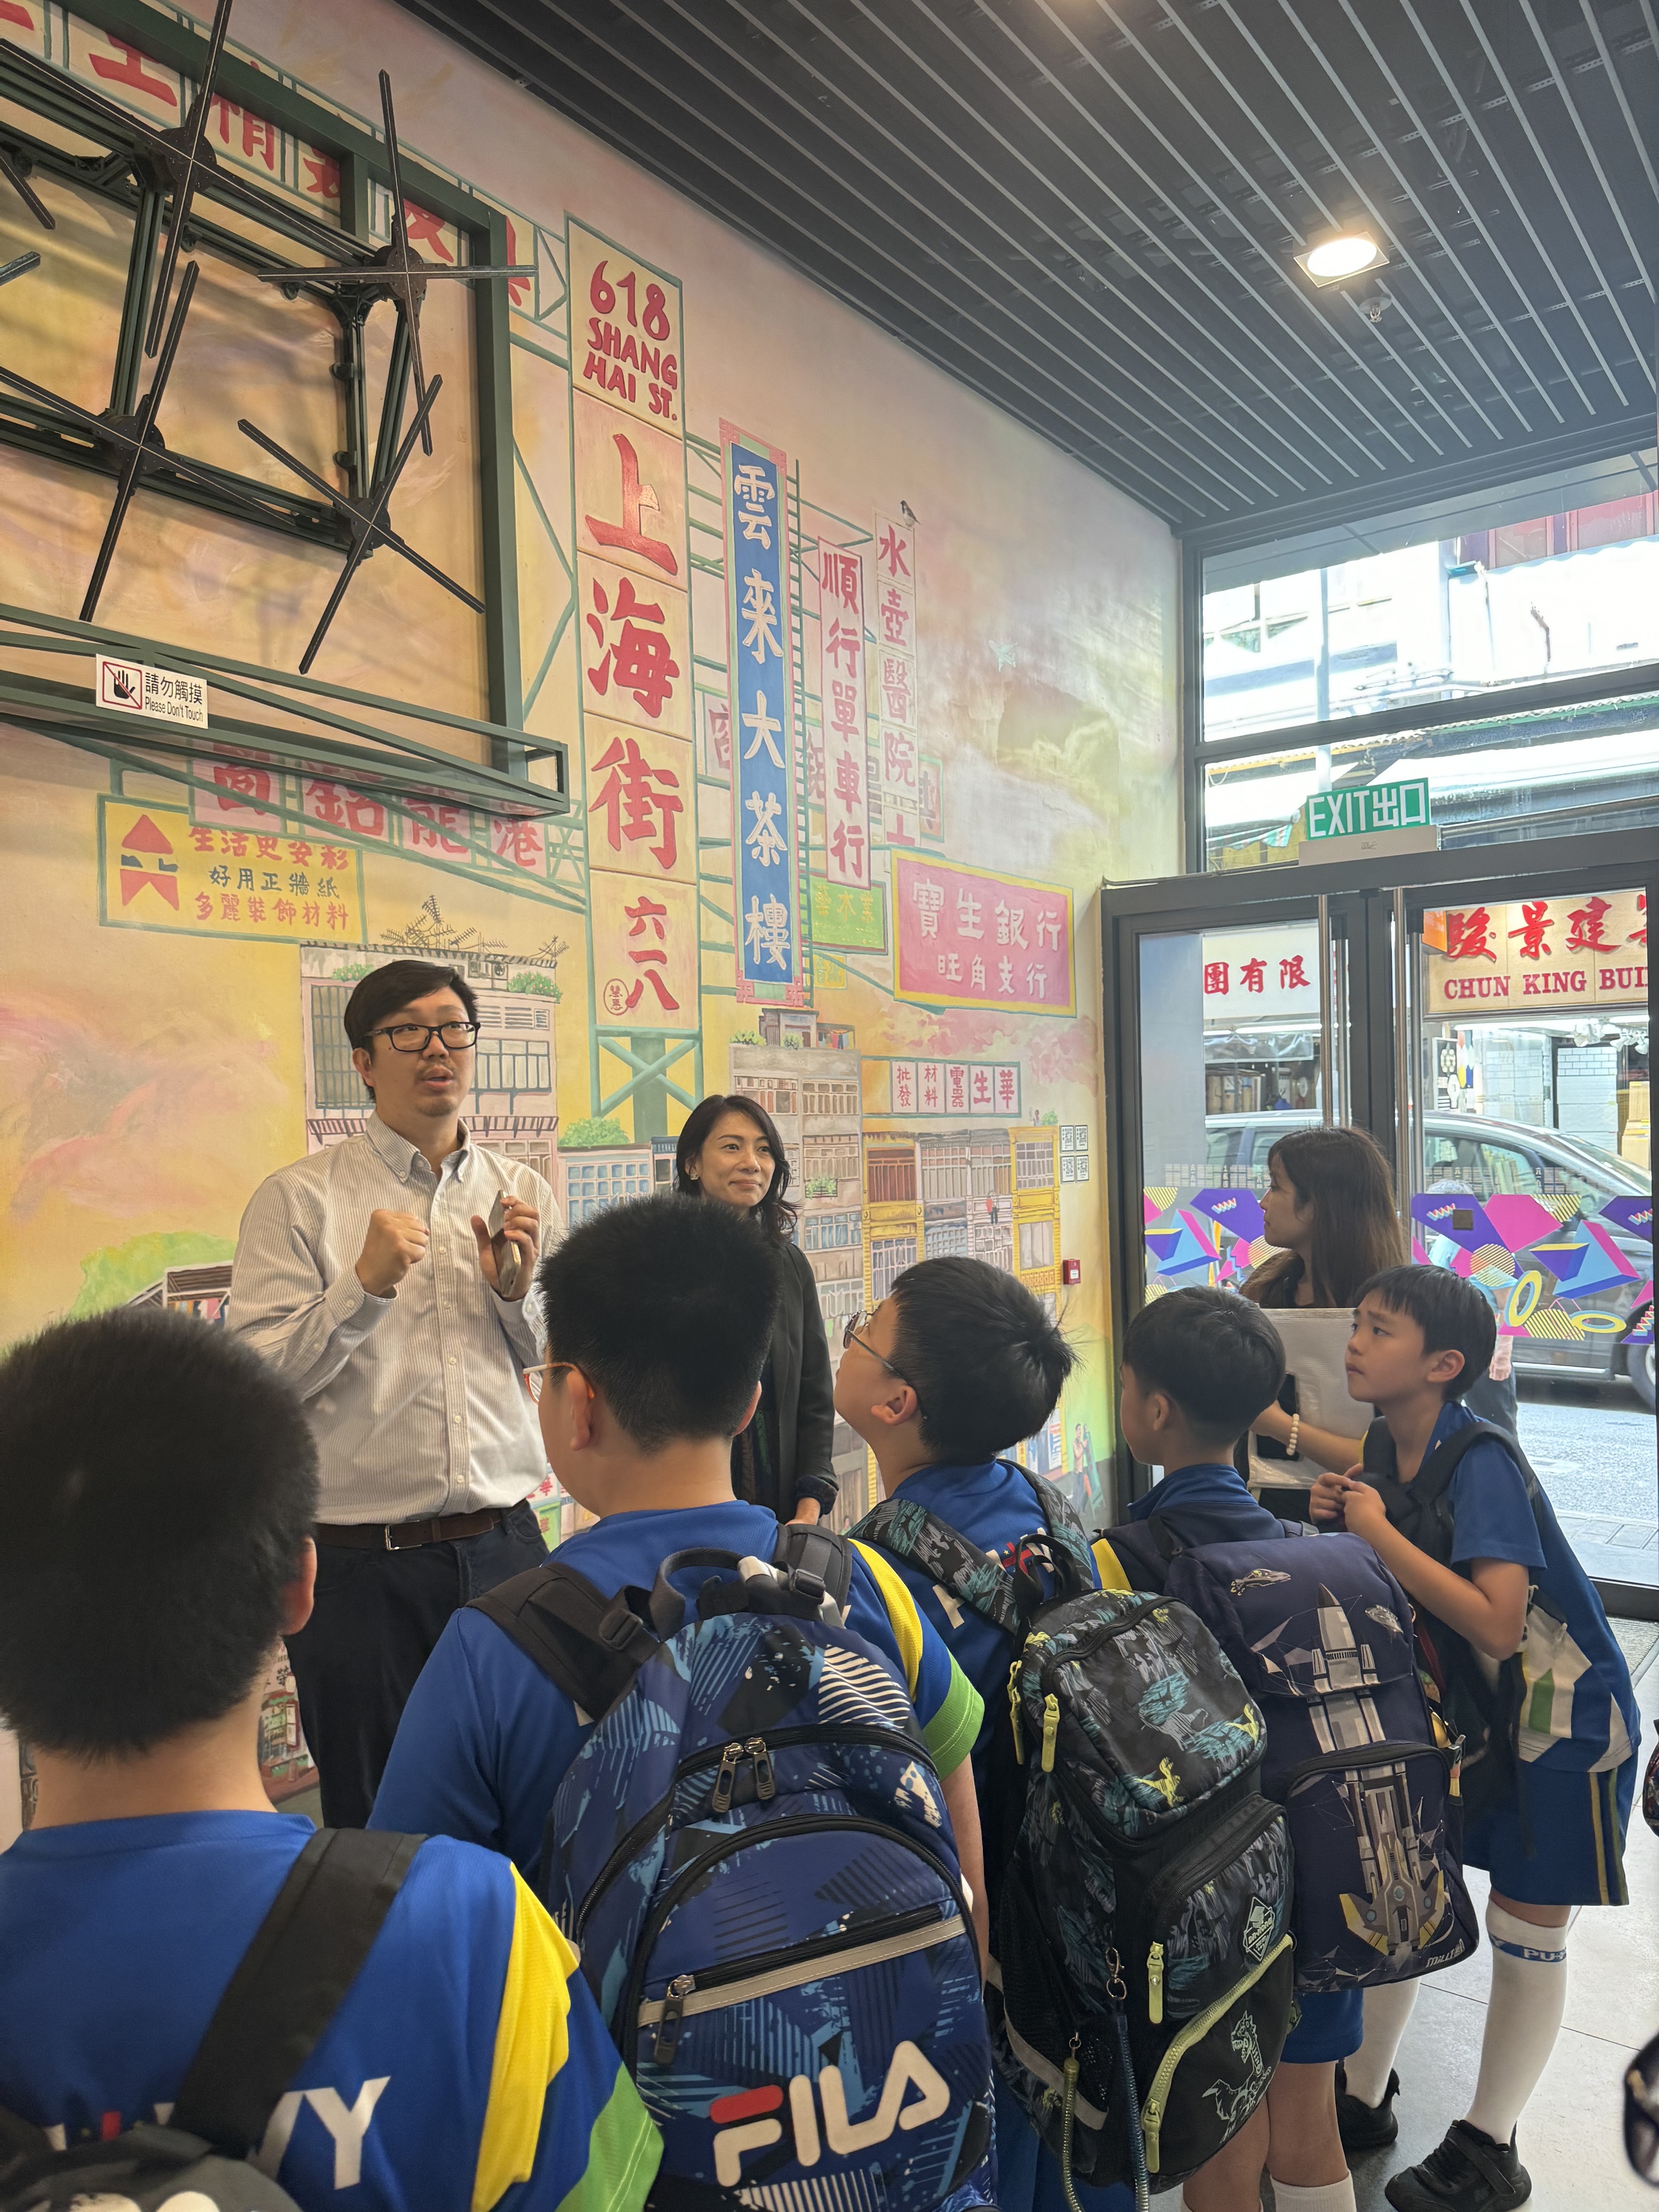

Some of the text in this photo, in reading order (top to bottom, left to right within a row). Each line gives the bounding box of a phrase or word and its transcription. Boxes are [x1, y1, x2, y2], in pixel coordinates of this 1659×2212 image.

[590, 260, 670, 341] 618
[588, 317, 677, 390] SHANG
[583, 351, 677, 421] HAI ST.
[145, 672, 202, 705] 請勿觸摸
[145, 697, 203, 721] Please Don't Touch
[734, 465, 790, 970] 雲來大茶樓
[822, 552, 866, 878] 順行單車行
[1309, 782, 1426, 838] EXIT 出口
[189, 827, 349, 871] 生活更姿彩
[195, 891, 349, 930] 多麗裝飾材料
[913, 878, 1062, 952] 寶生銀行
[938, 953, 1048, 1000] 旺角支行
[1444, 967, 1648, 1000] CHUN KING BUI
[710, 2041, 950, 2187] FILA
